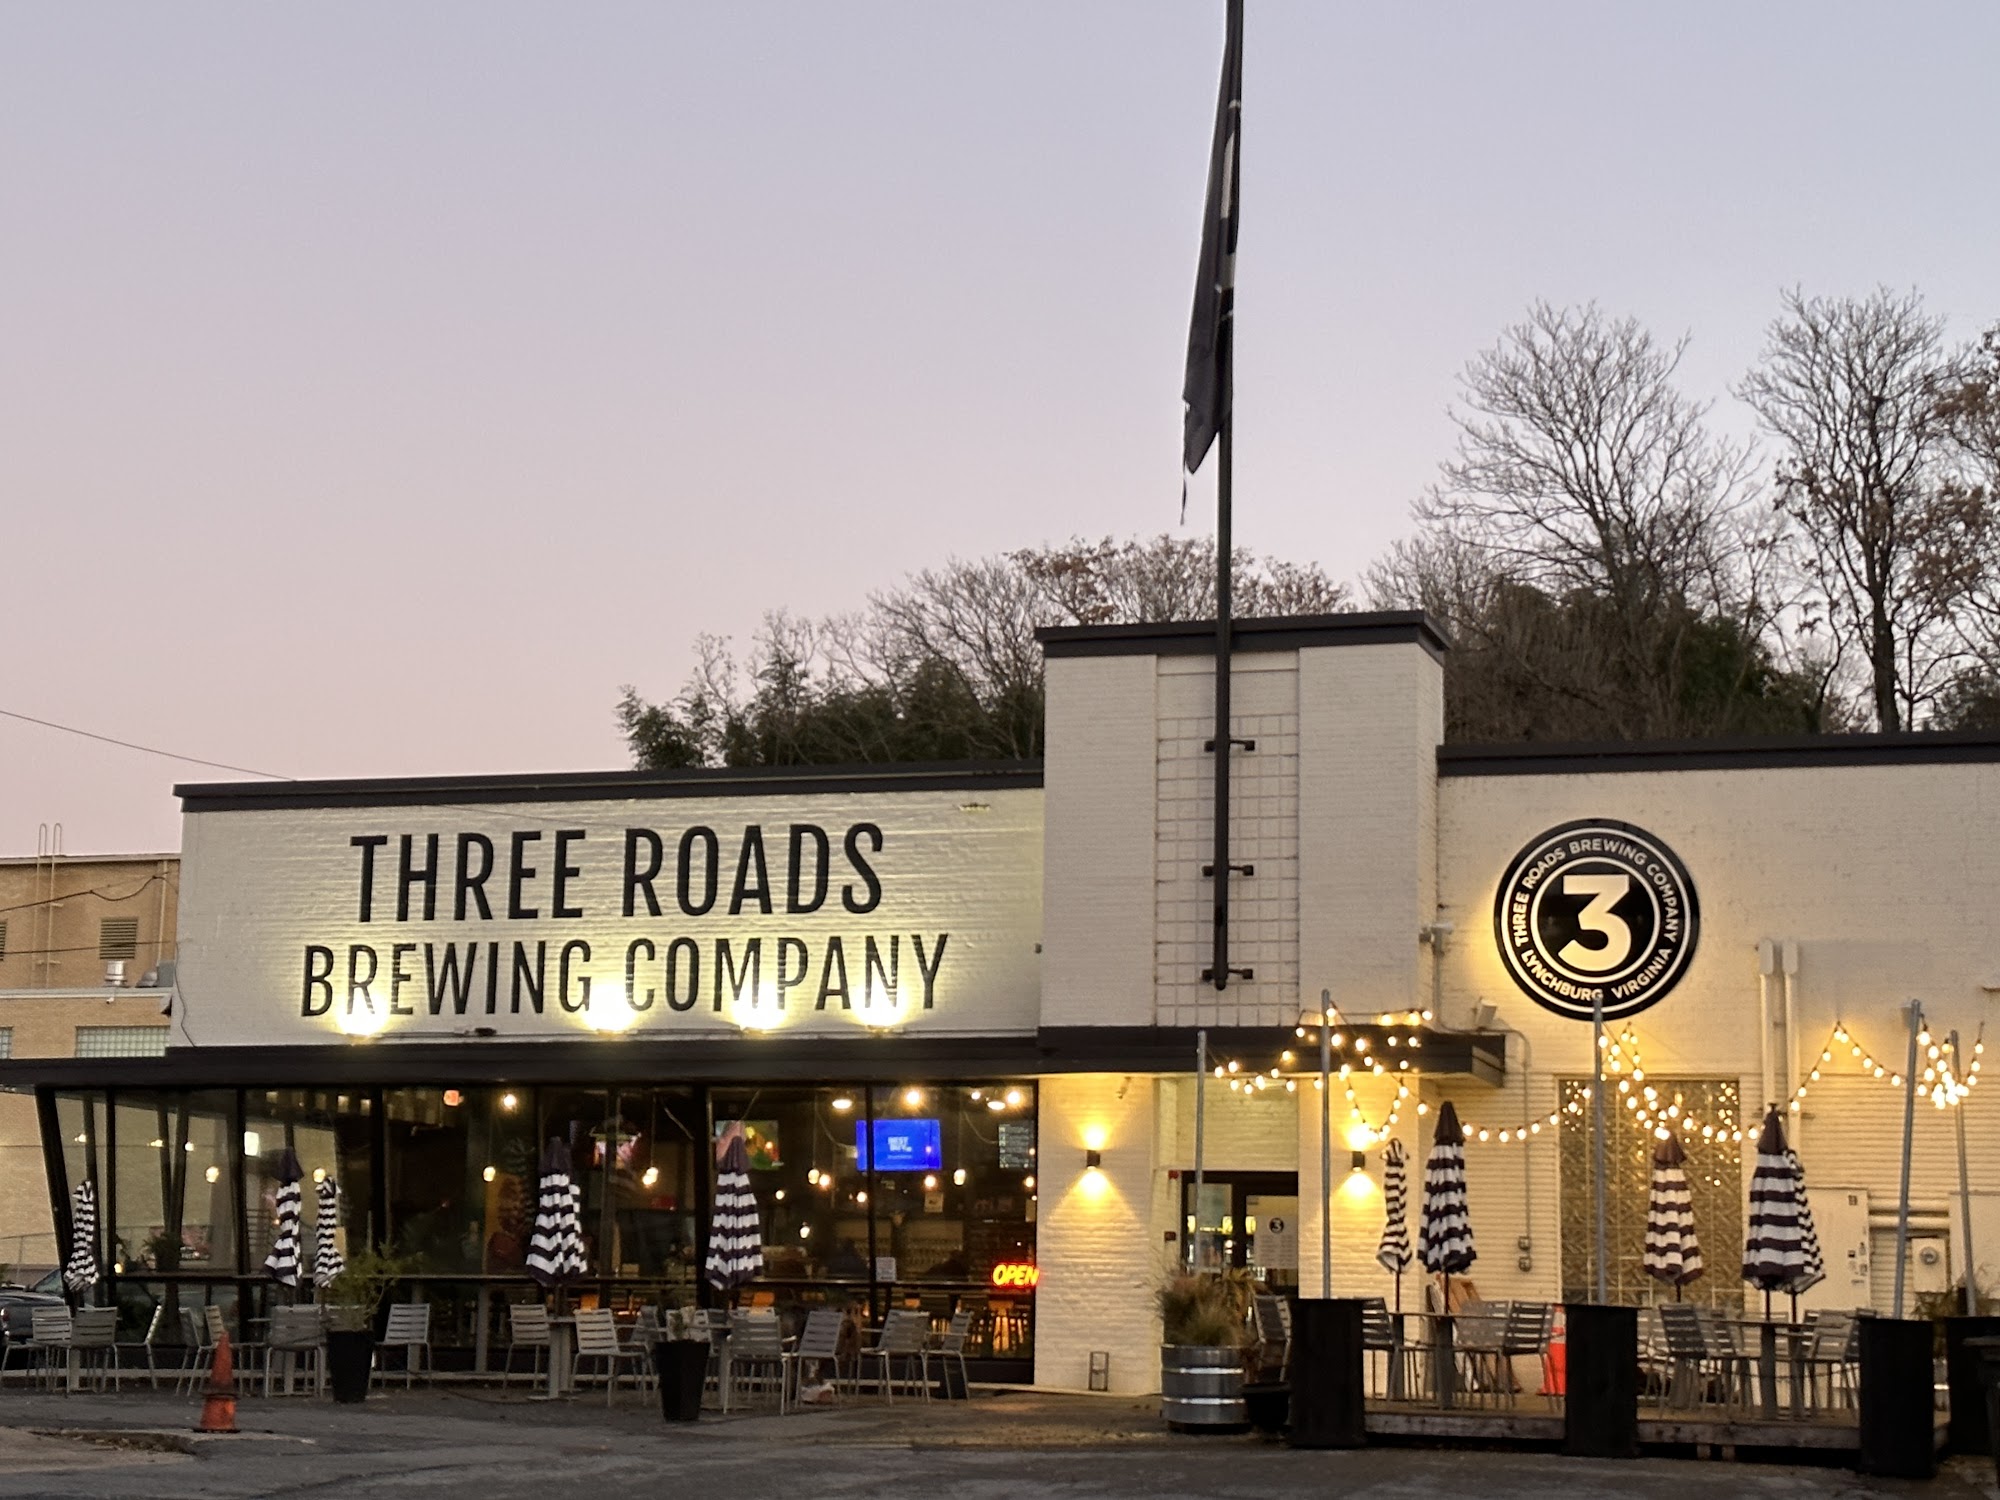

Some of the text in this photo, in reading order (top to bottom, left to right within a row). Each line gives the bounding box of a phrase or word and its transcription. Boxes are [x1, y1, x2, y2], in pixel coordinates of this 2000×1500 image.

[350, 822, 884, 923] THREE ROADS
[1512, 838, 1680, 948] THREE ROADS BREWING COMPANY
[1558, 874, 1632, 972] 3
[301, 933, 949, 1017] BREWING COMPANY
[1521, 948, 1673, 1001] LYNCHBURG VIRGINIA
[992, 1264, 1039, 1286] OPEN
